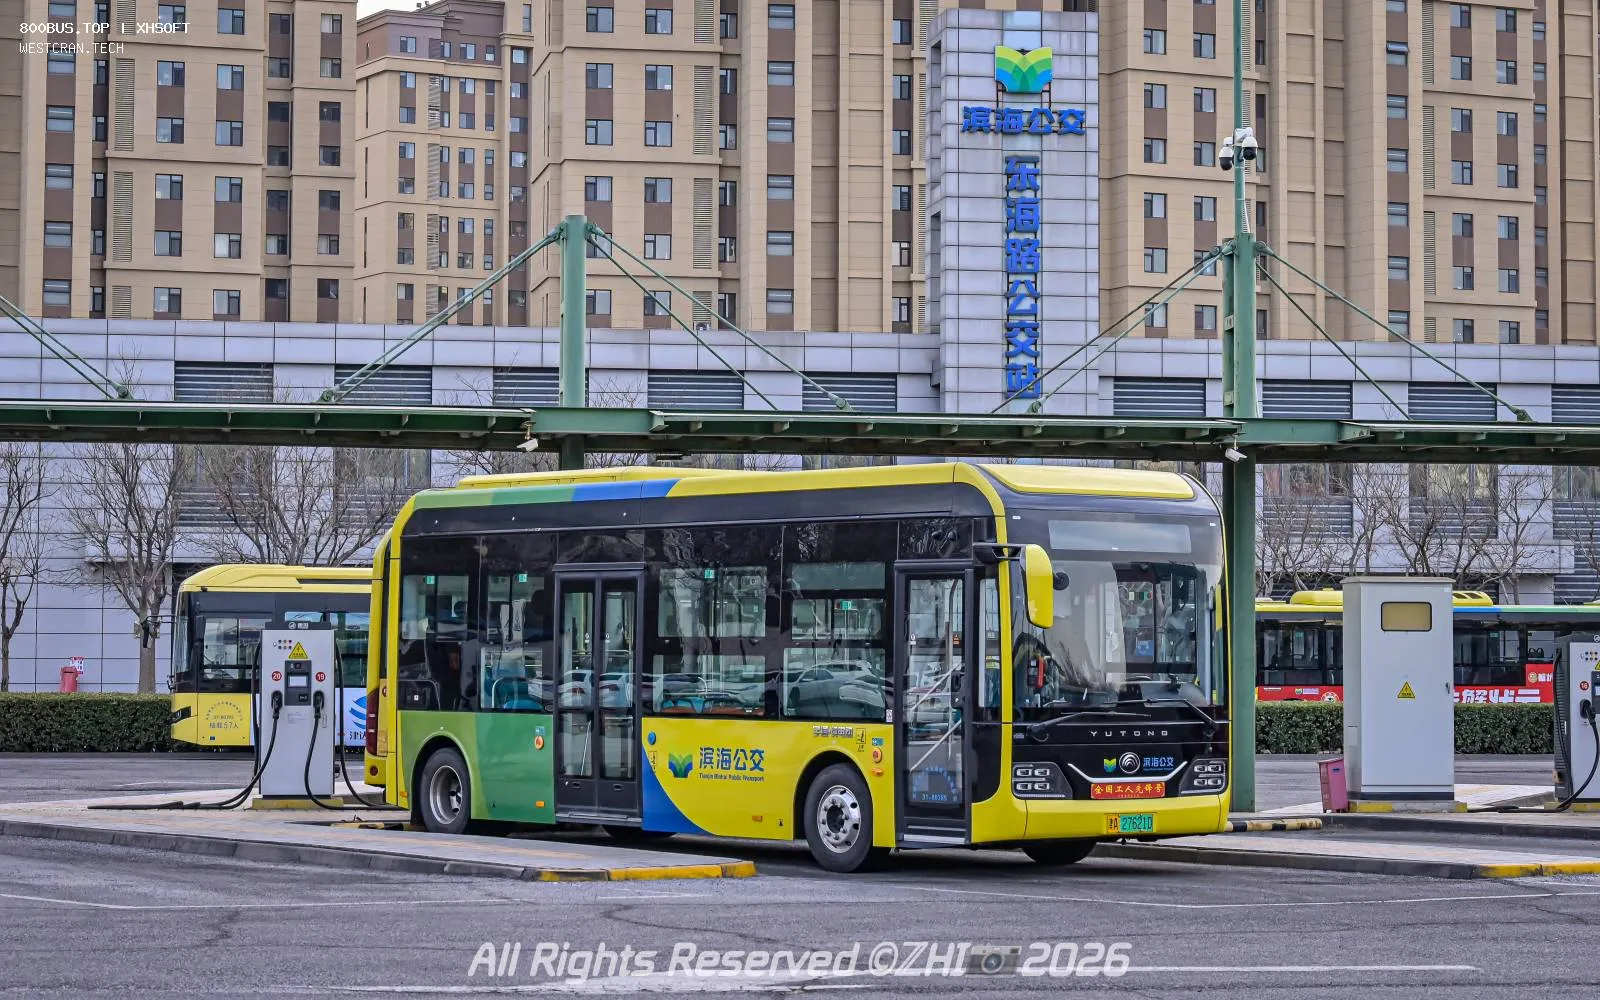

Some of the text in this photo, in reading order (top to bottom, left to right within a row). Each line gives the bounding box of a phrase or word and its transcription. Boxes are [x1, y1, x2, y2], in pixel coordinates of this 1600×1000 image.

[961, 105, 1086, 135] 滨海公交
[1005, 156, 1040, 399] 东海路公交站
[699, 746, 765, 771] 滨海公交
[1142, 756, 1174, 768] 滨海公交
[1094, 783, 1163, 795] 全国工人先锋号
[1122, 815, 1153, 830] 27621D
